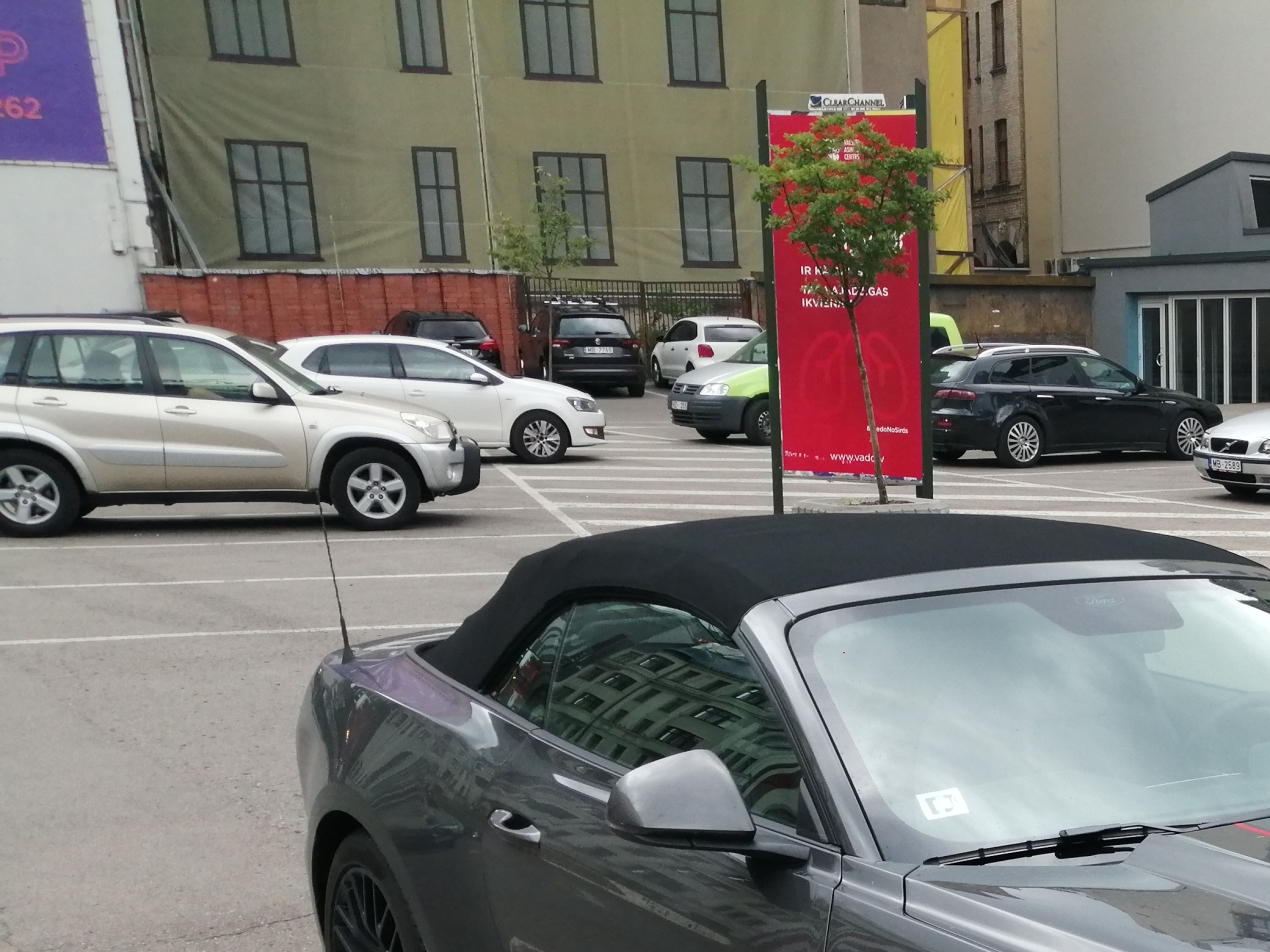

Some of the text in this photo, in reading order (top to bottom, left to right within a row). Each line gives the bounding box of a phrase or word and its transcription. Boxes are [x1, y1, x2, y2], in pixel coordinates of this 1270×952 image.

[0, 96, 42, 119] 62
[801, 265, 812, 275] IR
[1212, 459, 1241, 471] MB-2589
